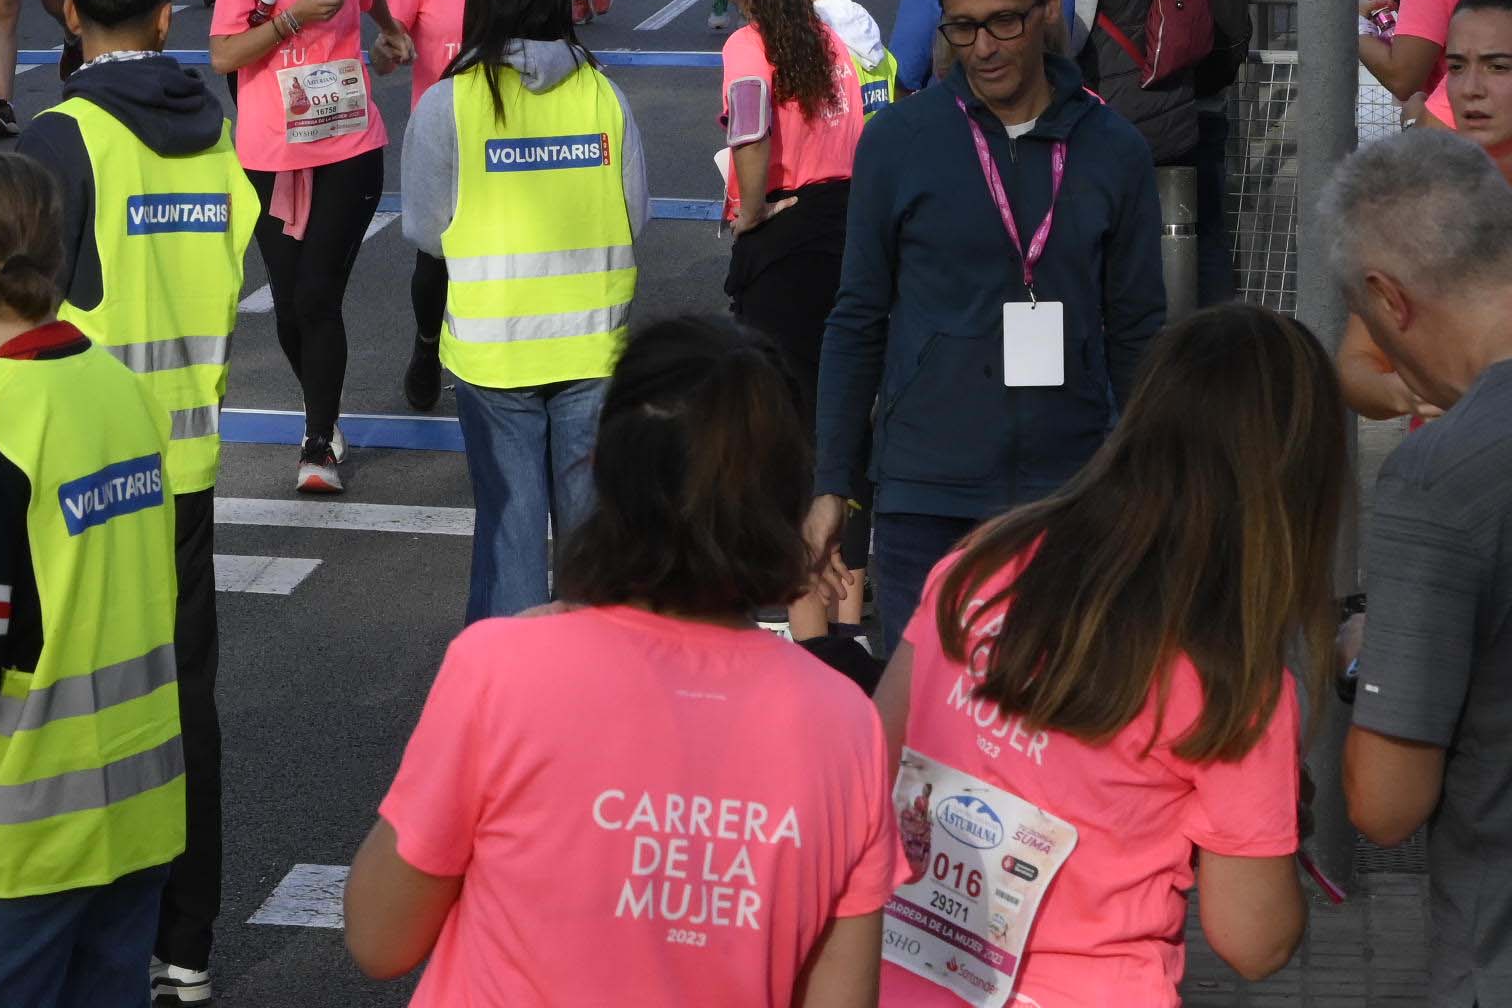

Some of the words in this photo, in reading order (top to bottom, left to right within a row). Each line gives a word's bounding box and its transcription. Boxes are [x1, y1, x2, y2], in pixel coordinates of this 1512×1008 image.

[280, 48, 306, 67] TU
[312, 92, 339, 106] 016
[316, 106, 337, 116] 16758
[292, 129, 319, 138] OYSHO
[489, 143, 600, 164] VOLUNTARIS
[130, 204, 229, 227] VOLUNTARIS
[65, 468, 163, 522] VOLUNTARIS
[947, 675, 1049, 766] MUJER
[593, 789, 802, 848] CARRERA
[941, 804, 997, 845] ASTURIANA
[1012, 830, 1052, 855] SUMA
[632, 838, 688, 878] DE
[702, 841, 755, 885] LA
[933, 851, 984, 898] 016
[615, 880, 762, 930] MUJER
[930, 890, 970, 923] 29371
[666, 928, 707, 946] 2023
[928, 919, 942, 932] DE
[942, 926, 955, 938] LA
[884, 928, 921, 956] SHO
